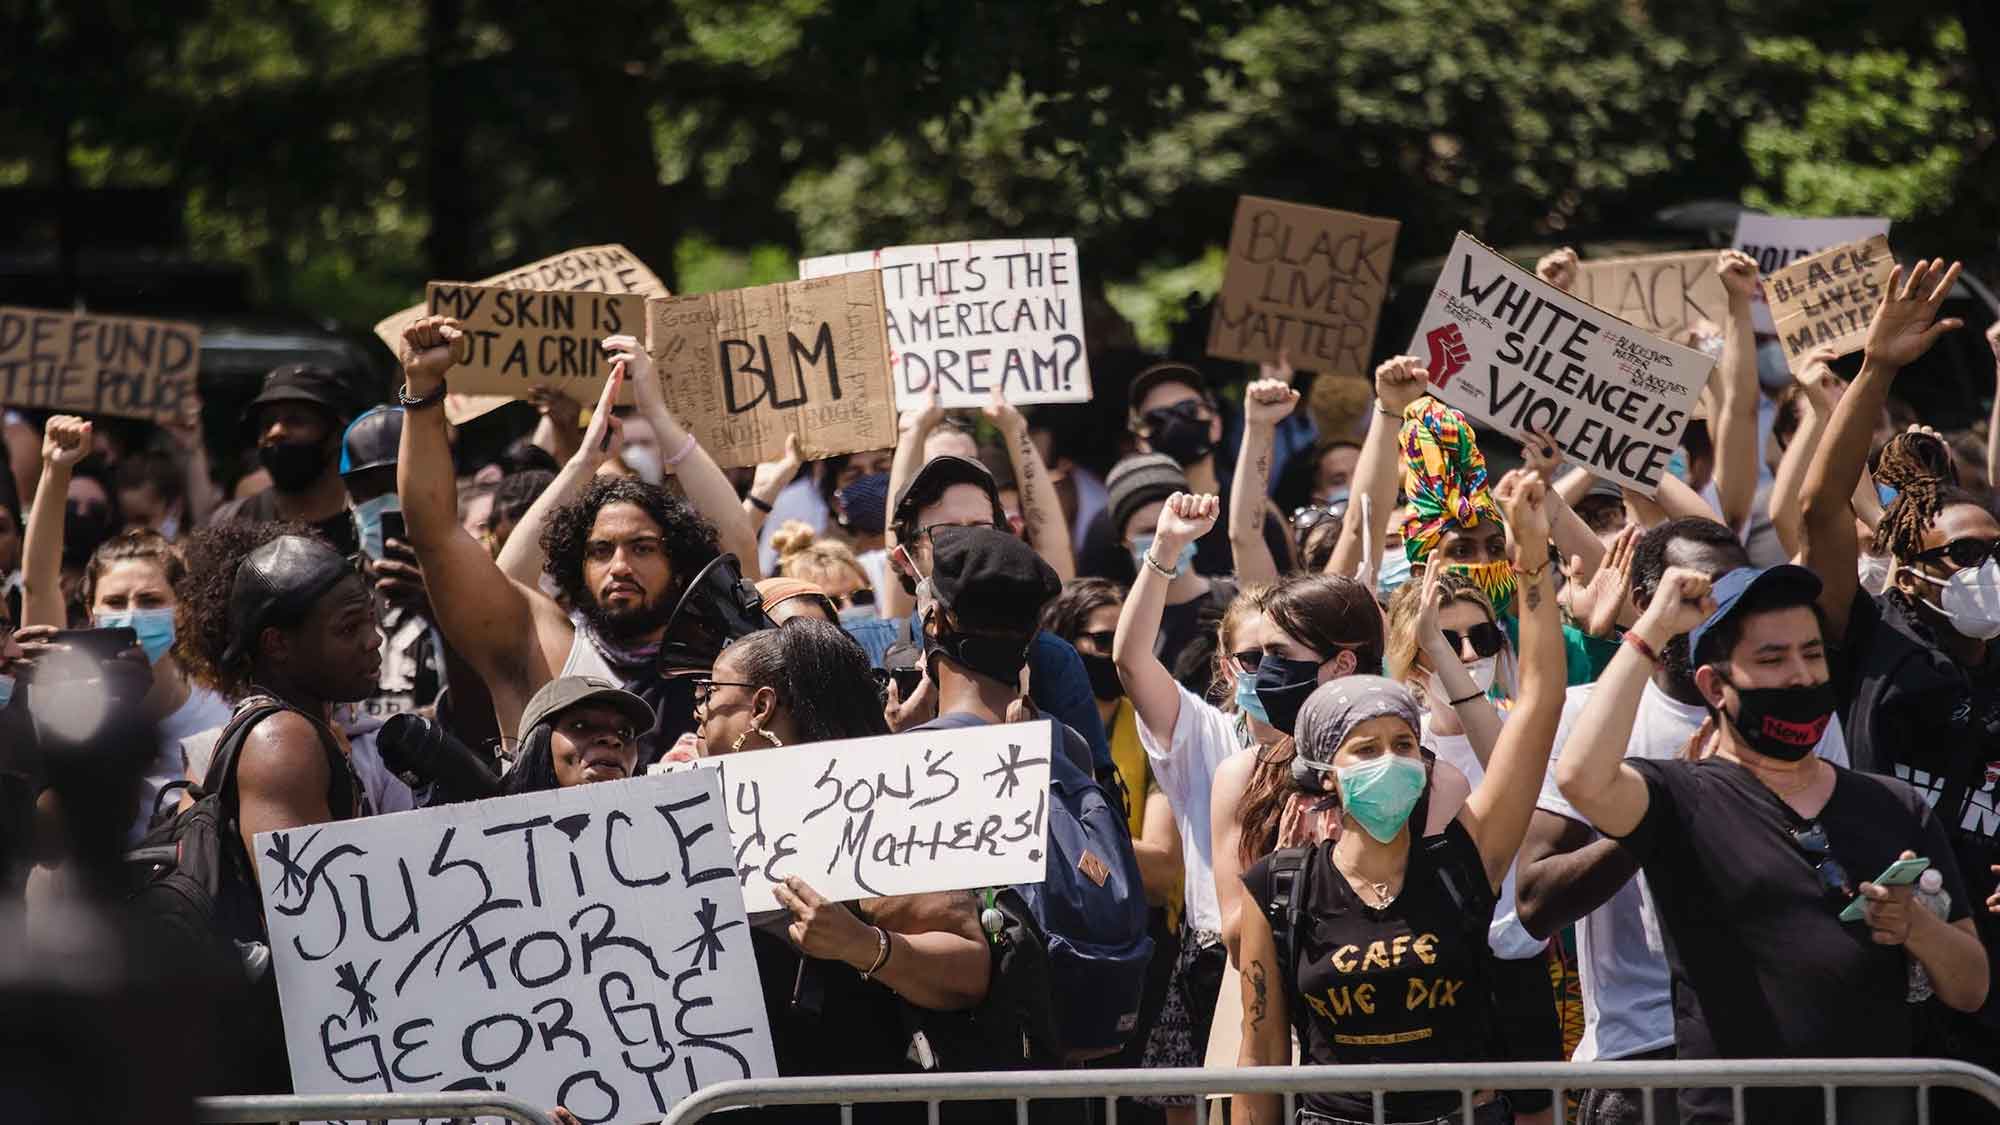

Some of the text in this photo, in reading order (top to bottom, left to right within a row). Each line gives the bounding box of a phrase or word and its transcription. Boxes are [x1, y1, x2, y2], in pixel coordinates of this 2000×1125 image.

[883, 253, 1069, 299] THIS THE
[1240, 210, 1392, 286] BLACK
[1774, 244, 1878, 302] BLACK
[432, 287, 622, 333] MY SKIN IS
[886, 298, 1066, 345] AMERICAN
[1260, 265, 1370, 322] LIVES
[1461, 254, 1600, 362] WHITE
[1802, 273, 1880, 317] LIVES
[0, 314, 192, 373] DEFUND
[461, 330, 500, 366] OT
[501, 337, 528, 378] A
[1211, 302, 1368, 373] MATTER
[1787, 305, 1876, 357] MATTE
[0, 360, 84, 405] THE
[720, 321, 842, 415] BLM
[903, 334, 1081, 394] DREAM?
[1495, 331, 1685, 437] SILENCE IS
[1490, 364, 1673, 488] VIOLENCE
[803, 748, 959, 823] SON'S
[396, 899, 670, 997] FOR
[1331, 933, 1440, 973] CAFE
[1406, 977, 1464, 1011] DIX
[321, 967, 754, 1093] GEORGE
